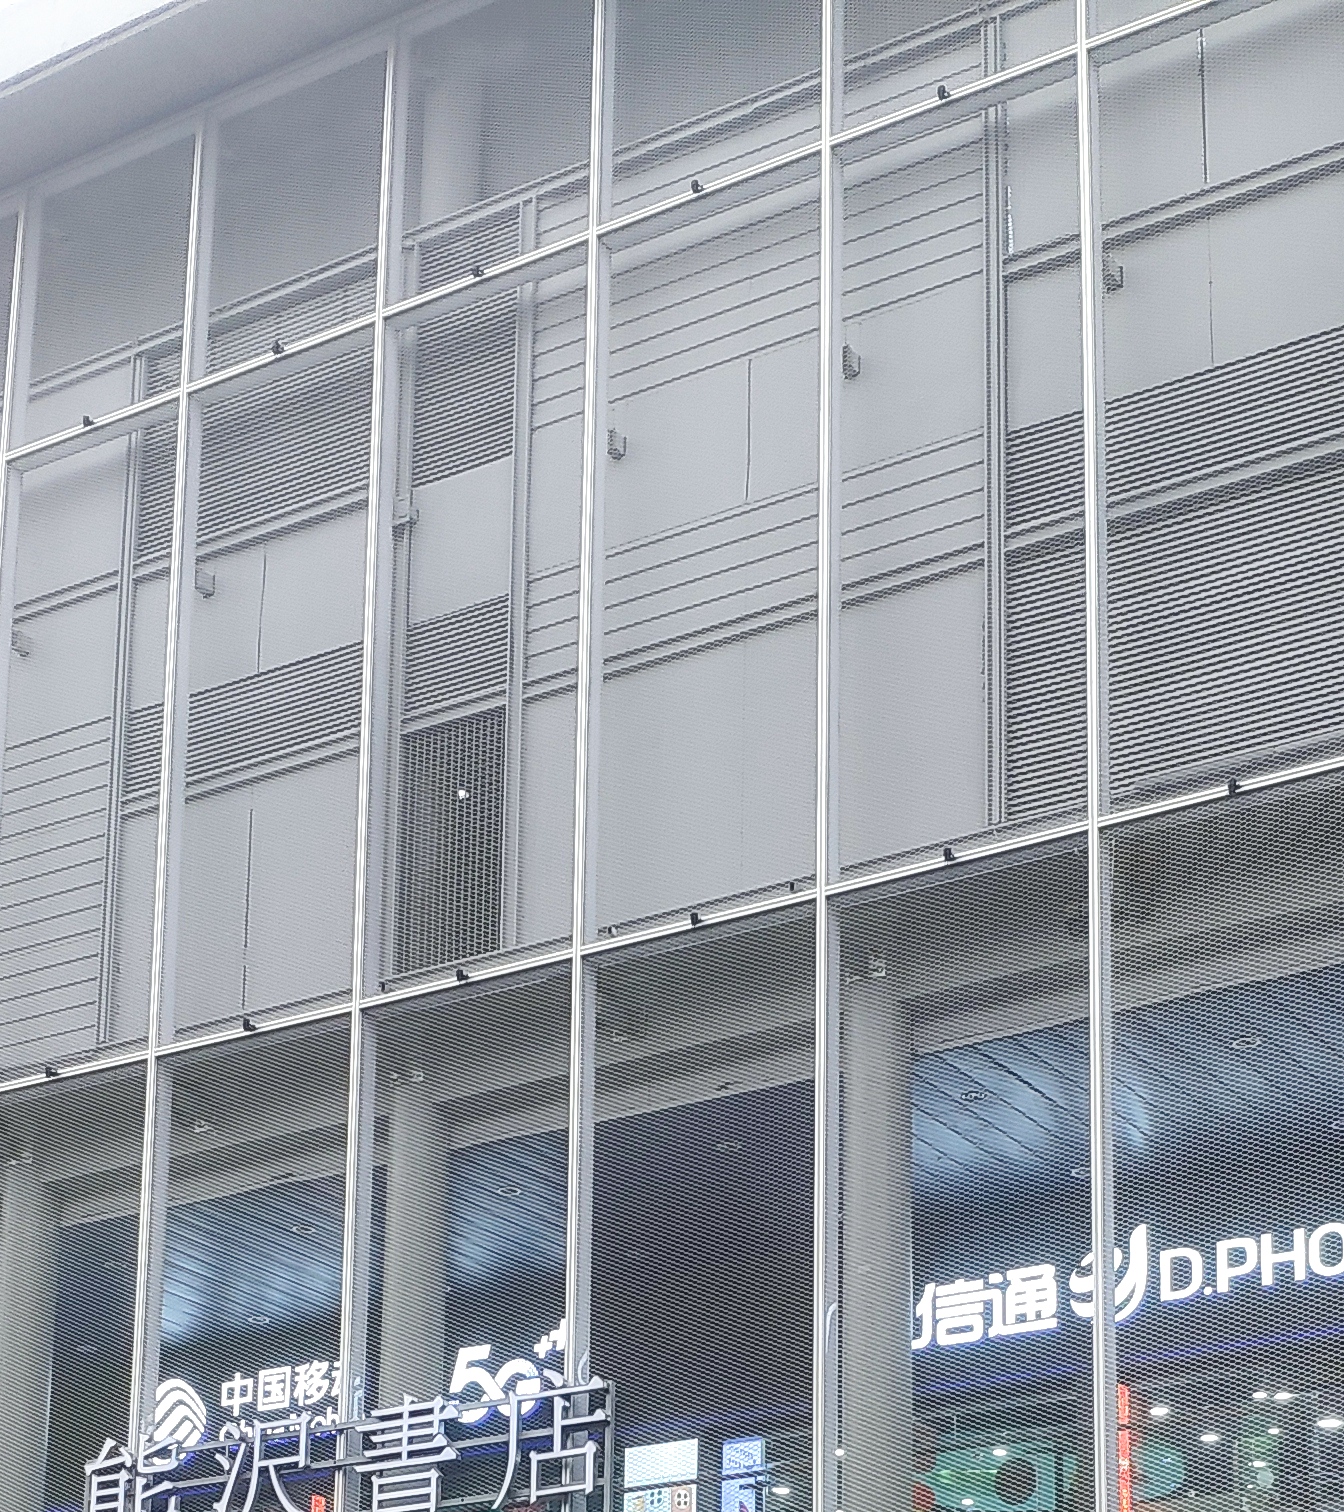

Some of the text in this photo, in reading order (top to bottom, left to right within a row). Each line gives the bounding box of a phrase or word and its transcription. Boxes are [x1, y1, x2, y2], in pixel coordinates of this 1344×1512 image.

[911, 1262, 1058, 1350] 信通
[220, 1360, 341, 1417] 中国移
